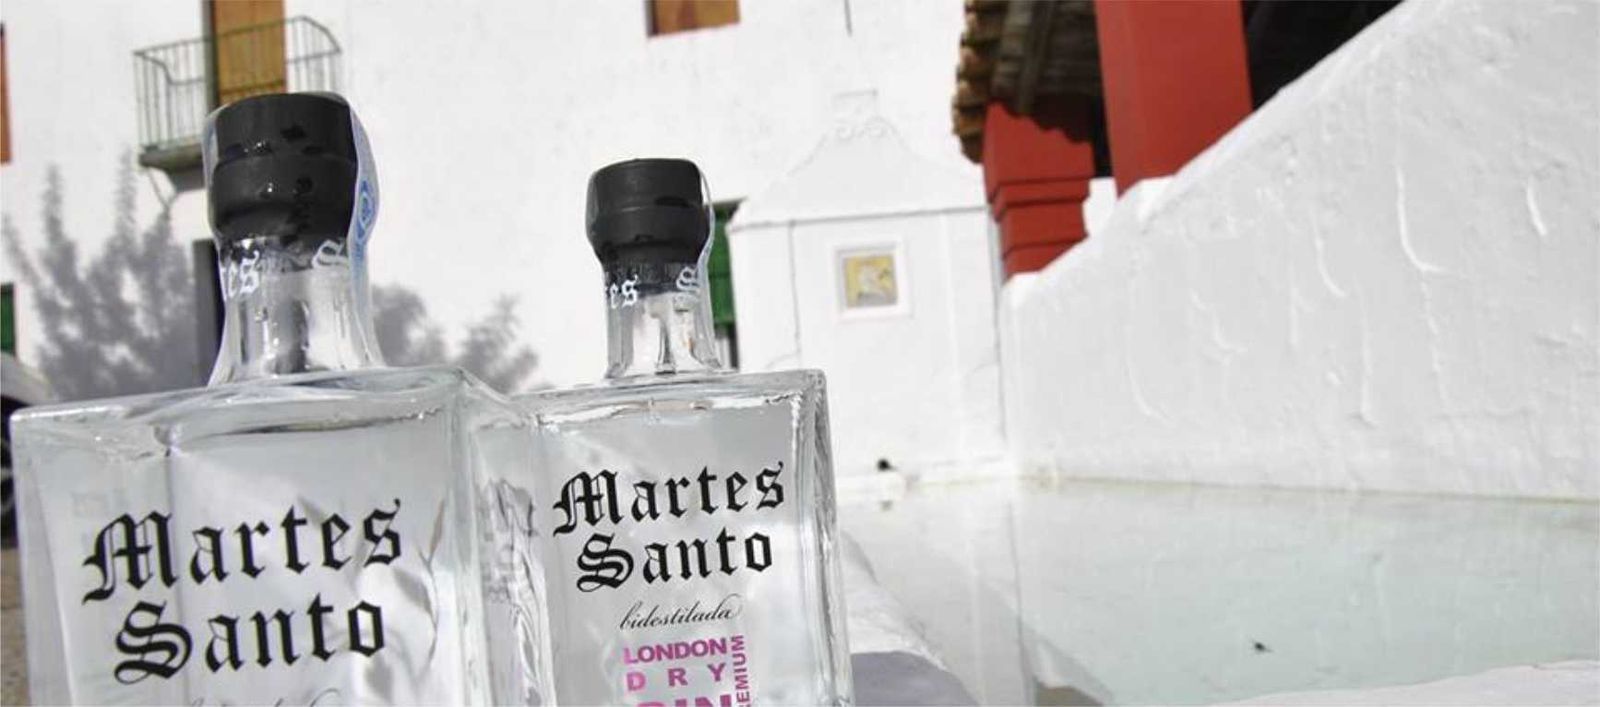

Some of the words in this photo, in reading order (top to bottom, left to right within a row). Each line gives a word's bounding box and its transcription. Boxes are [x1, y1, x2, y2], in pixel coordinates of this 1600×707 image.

[553, 461, 784, 537] Martes
[82, 498, 402, 604] Martes
[576, 527, 772, 593] Santo
[114, 593, 385, 685] Santo
[619, 593, 742, 631] bidestilada
[623, 637, 727, 665] LONDON
[730, 635, 751, 707] EMIUM
